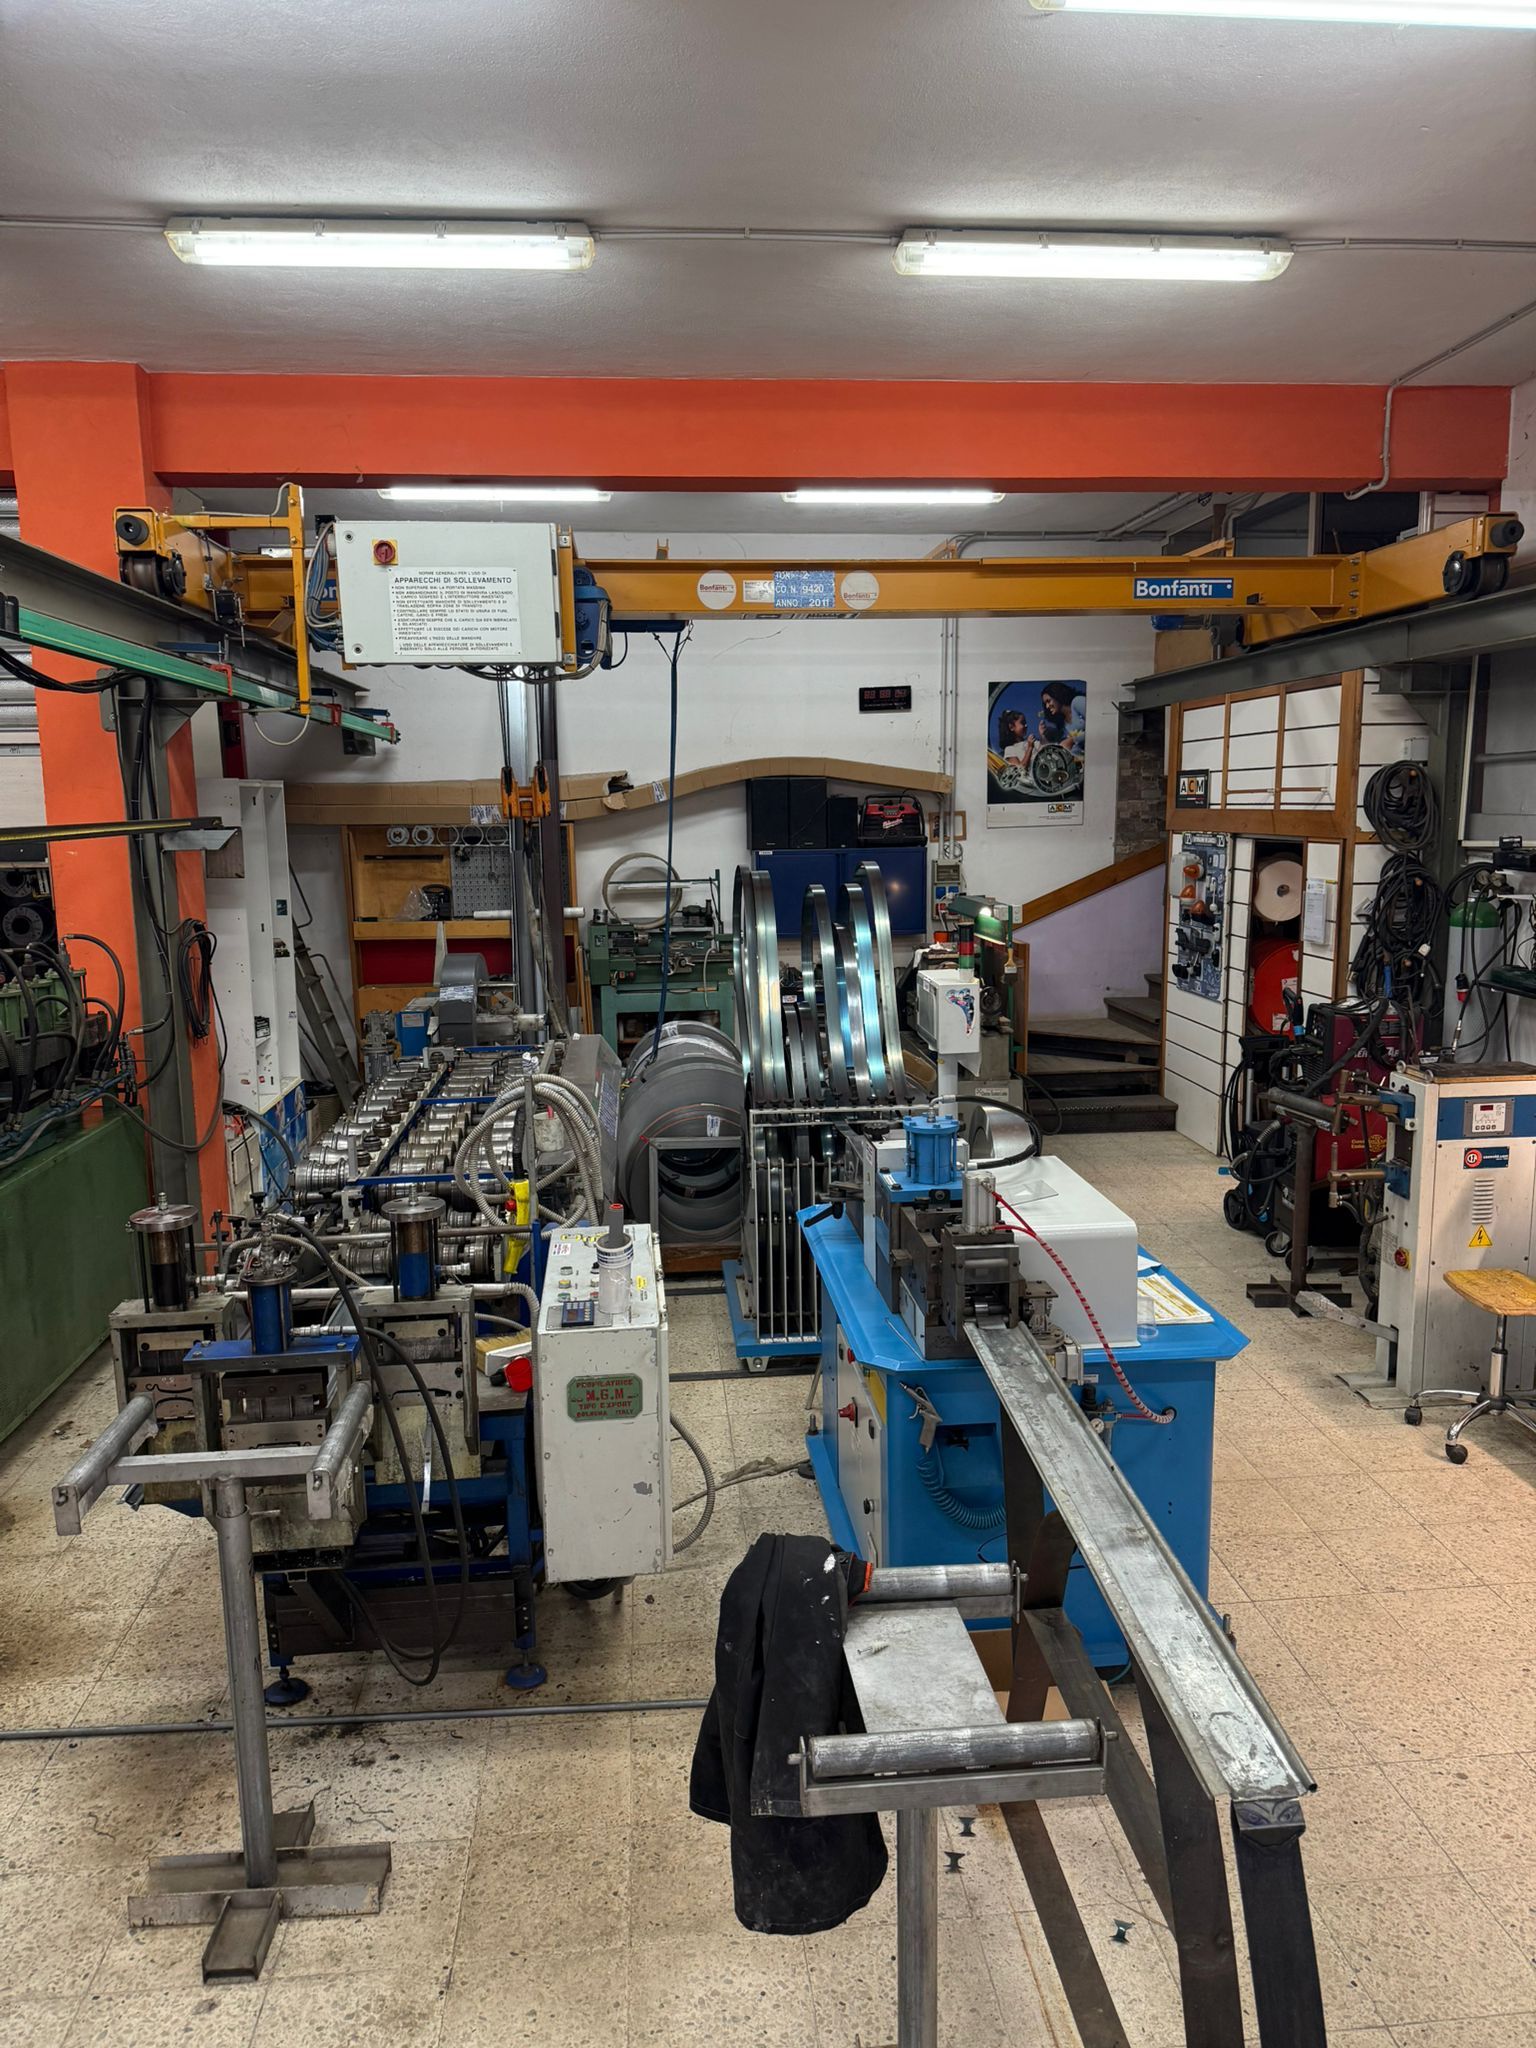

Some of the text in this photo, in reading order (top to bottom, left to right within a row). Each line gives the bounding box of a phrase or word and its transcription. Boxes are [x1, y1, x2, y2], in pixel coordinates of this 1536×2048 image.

[802, 584, 824, 594] 9420
[1136, 580, 1212, 596] Bonfanti
[809, 598, 829, 607] 2011
[1180, 780, 1204, 792] ACM
[1049, 804, 1072, 812] ACM
[600, 1400, 632, 1409] EXPORT
